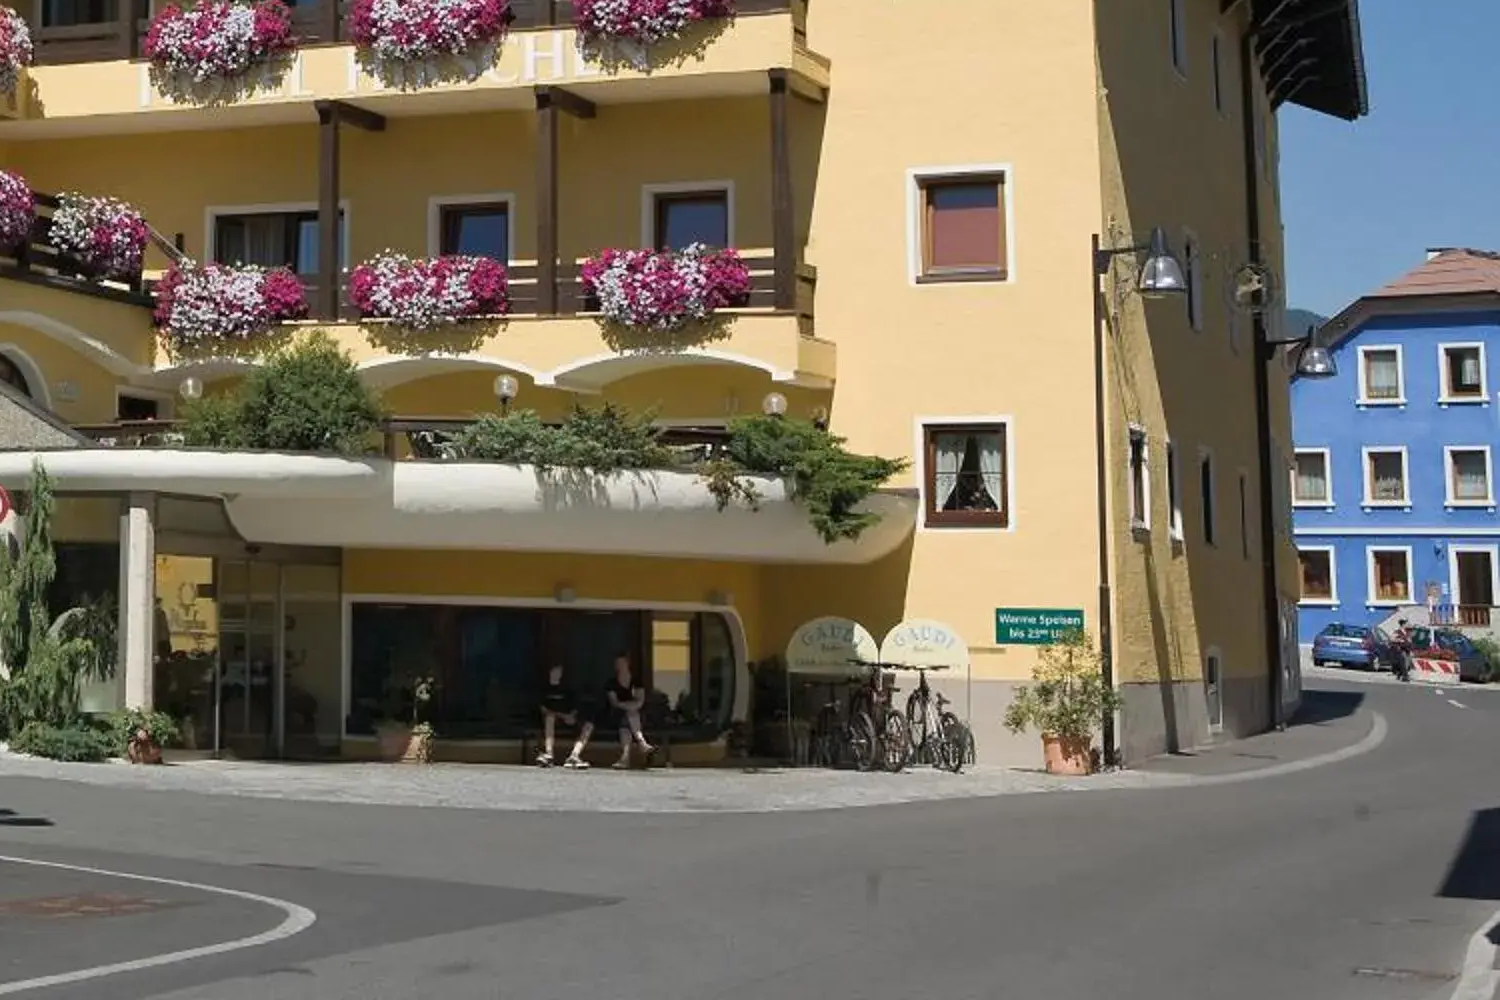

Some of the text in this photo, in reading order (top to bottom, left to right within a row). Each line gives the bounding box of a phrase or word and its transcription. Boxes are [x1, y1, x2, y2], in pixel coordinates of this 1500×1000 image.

[999, 613, 1081, 627] Warme Speisen
[1009, 627, 1025, 639] bis
